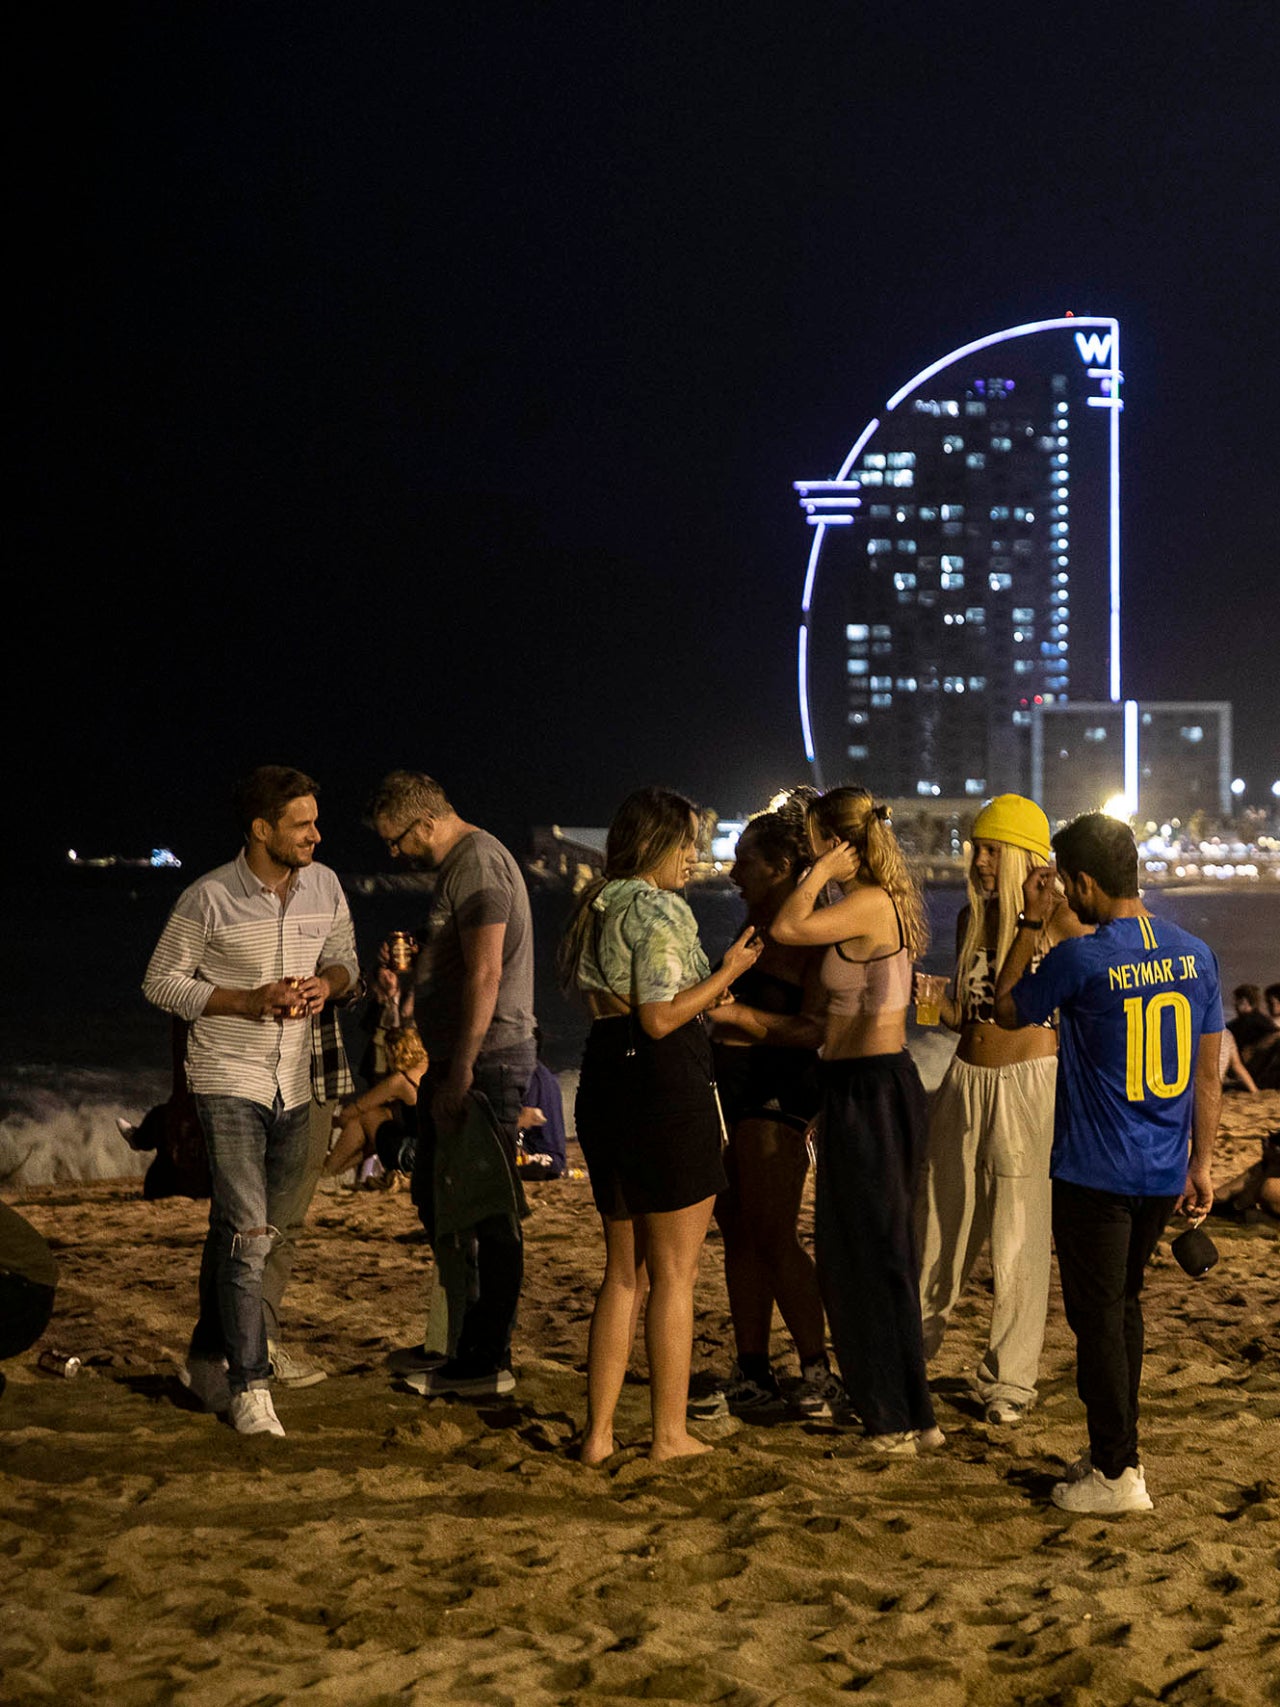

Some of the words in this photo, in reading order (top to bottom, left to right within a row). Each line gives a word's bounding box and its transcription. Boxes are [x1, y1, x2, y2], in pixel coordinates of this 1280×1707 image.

[1074, 332, 1113, 365] W
[1108, 958, 1175, 991] NEYMAR
[1178, 954, 1199, 980] JR
[1123, 991, 1192, 1101] 10
